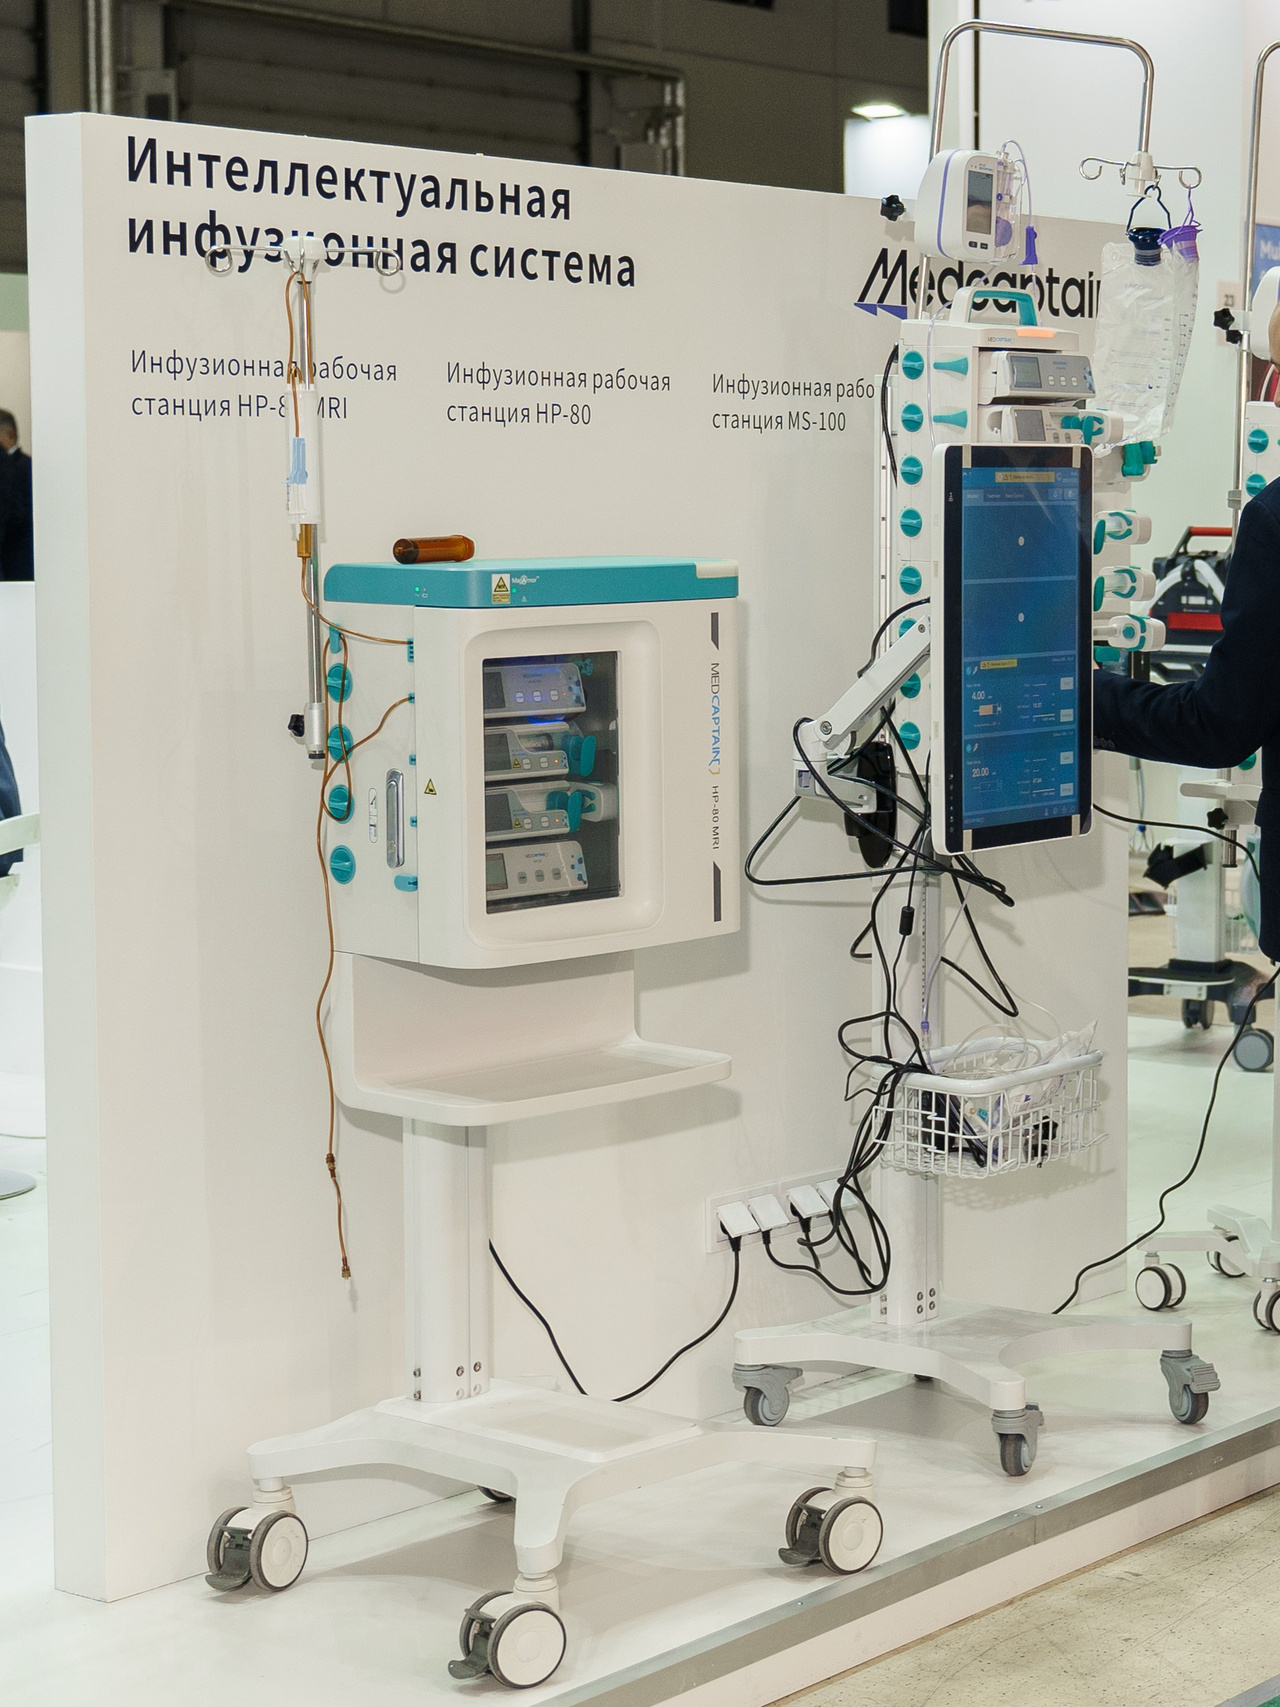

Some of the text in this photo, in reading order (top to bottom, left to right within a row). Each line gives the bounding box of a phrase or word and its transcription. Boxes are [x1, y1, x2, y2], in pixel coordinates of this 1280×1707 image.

[127, 135, 571, 221] Интеллектуальная
[128, 209, 636, 287] инфузонная система
[312, 355, 397, 381] абочая
[446, 361, 671, 395] Инфузионная рабочая
[712, 373, 876, 403] Инфузионная рабо
[131, 396, 231, 422] станция
[238, 394, 286, 418] HP-8
[446, 402, 592, 427] станция HP-80
[712, 410, 846, 432] станция MS-100
[708, 662, 720, 768] MEDCAPTAIN
[712, 826, 720, 850] MRI
